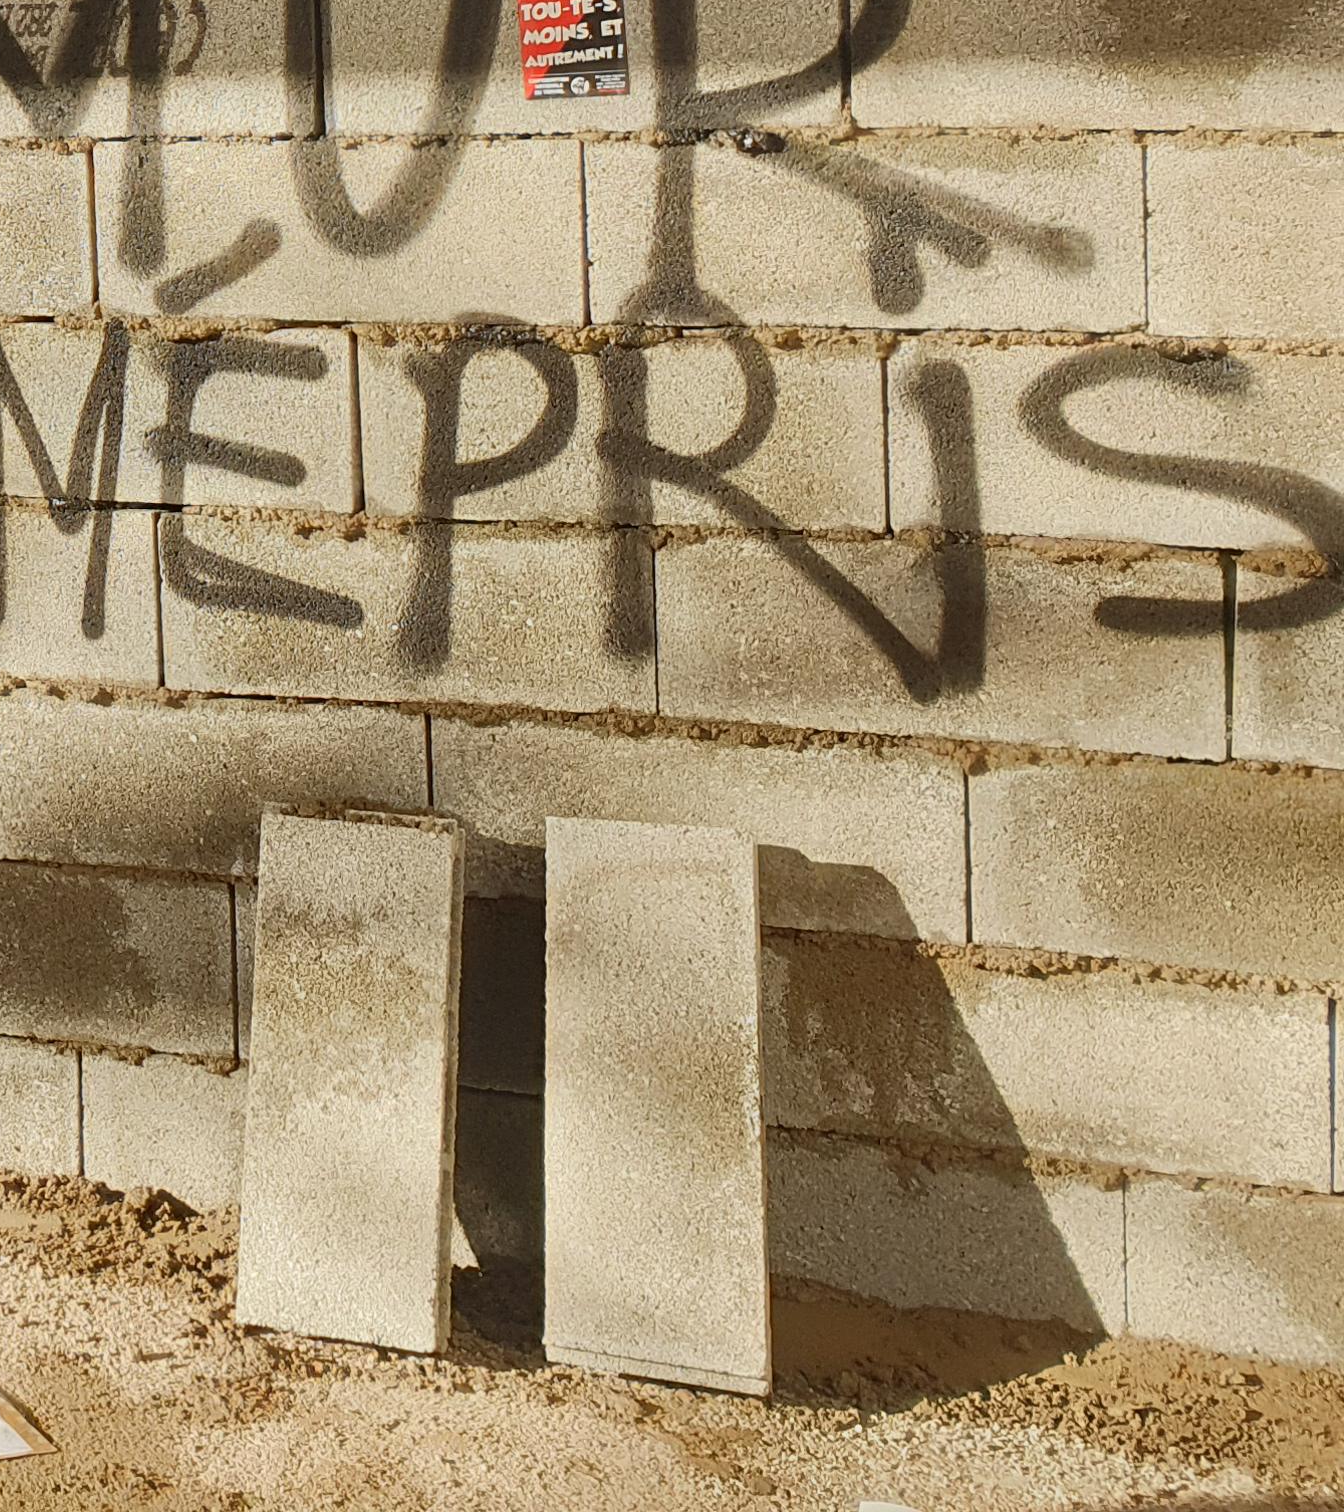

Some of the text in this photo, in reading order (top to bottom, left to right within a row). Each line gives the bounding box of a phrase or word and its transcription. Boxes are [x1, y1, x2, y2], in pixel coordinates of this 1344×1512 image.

[523, 18, 623, 45] MOINS, ET
[525, 46, 614, 68] AUTREMENT
